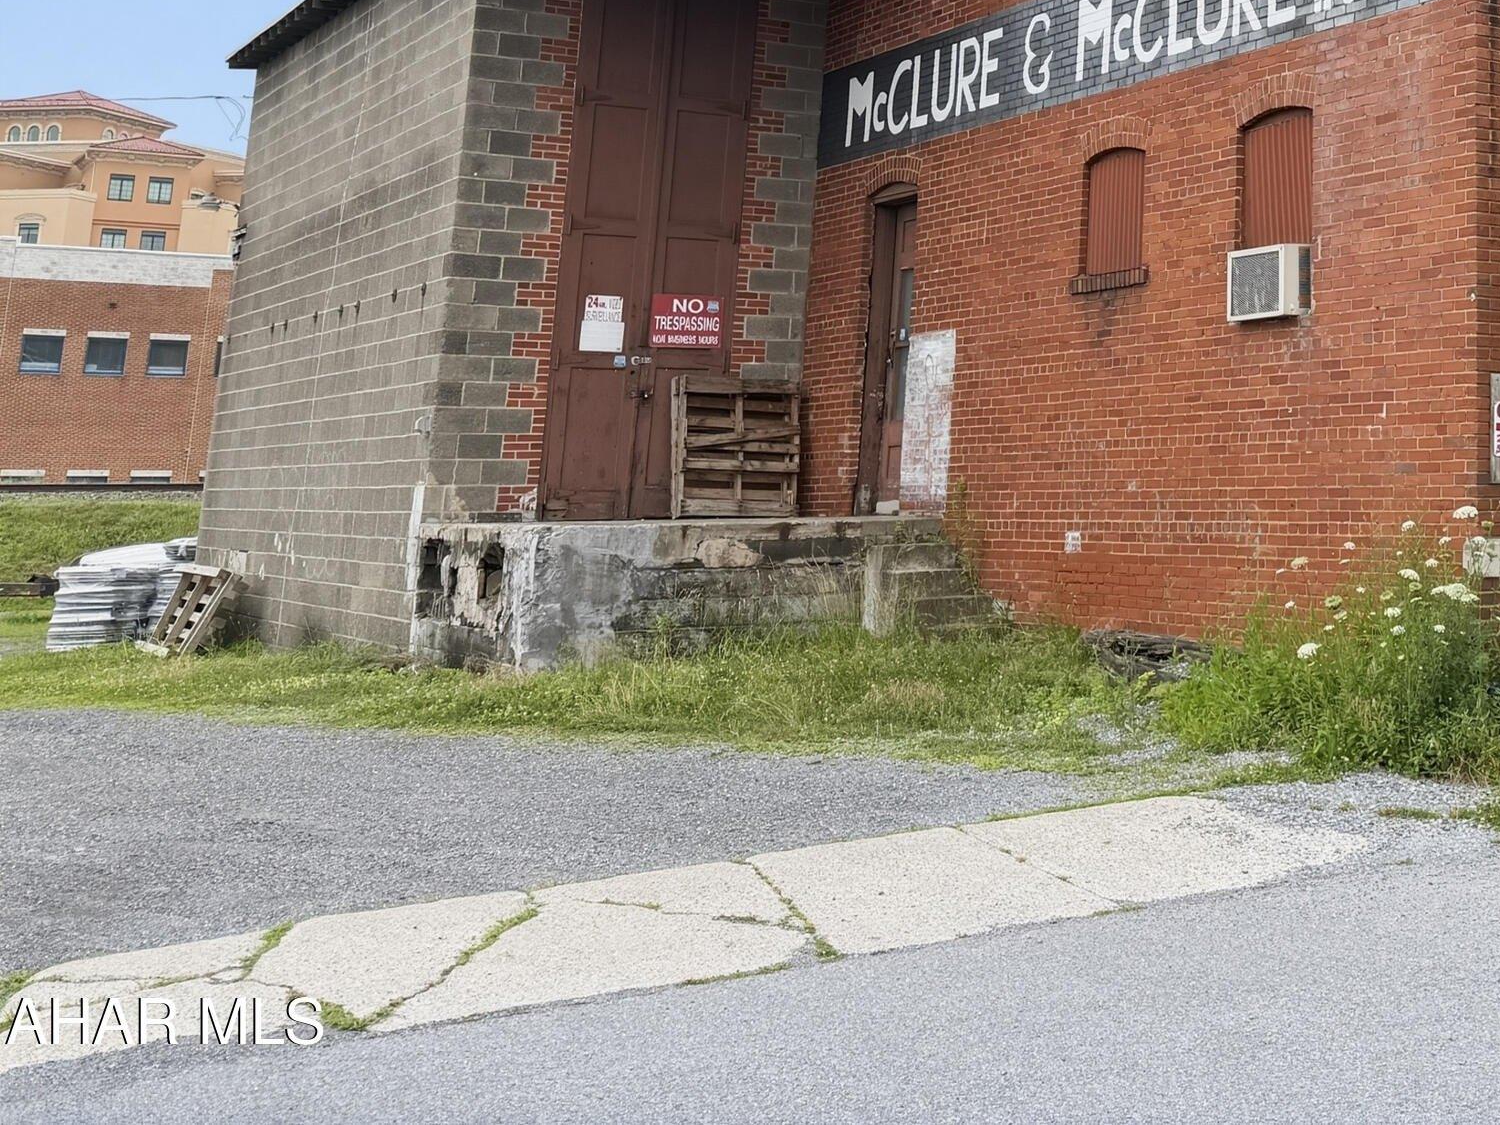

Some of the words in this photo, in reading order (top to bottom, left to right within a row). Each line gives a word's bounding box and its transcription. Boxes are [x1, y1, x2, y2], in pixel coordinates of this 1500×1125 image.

[844, 28, 1003, 148] McCLURE
[1022, 13, 1052, 95] &
[588, 296, 598, 308] 24
[672, 298, 704, 314] NO
[654, 315, 720, 332] TRESPASSING
[667, 335, 697, 345] BUSINESS
